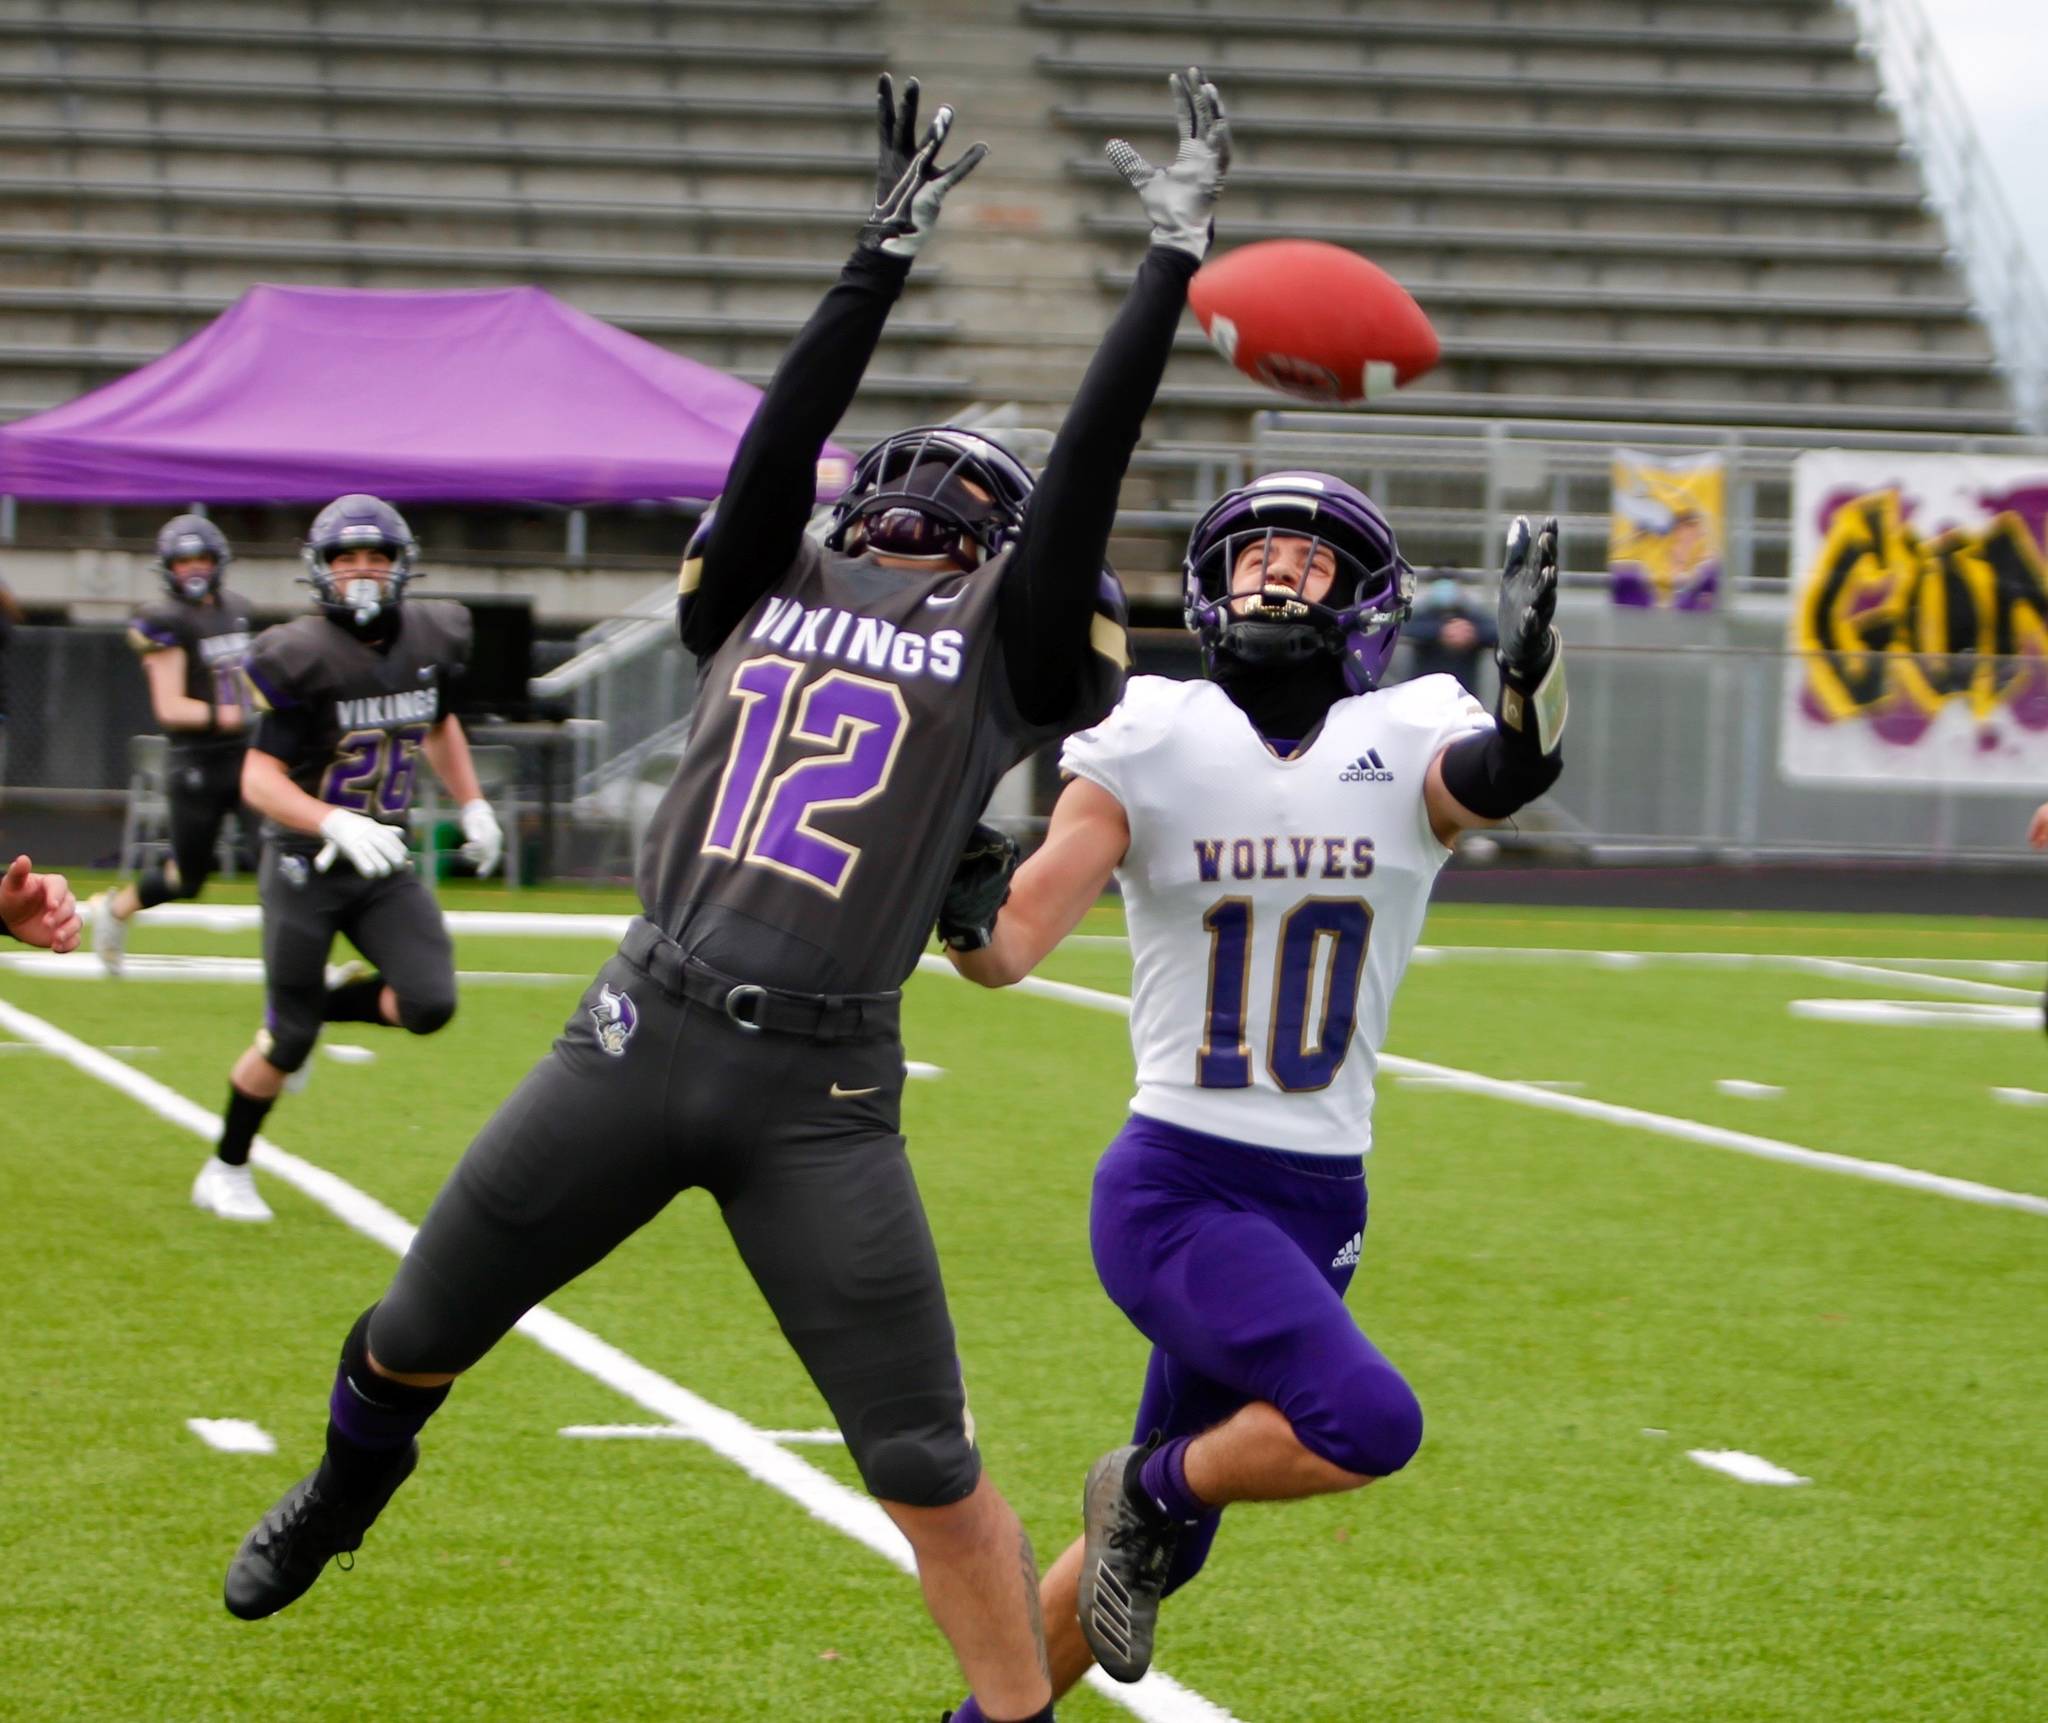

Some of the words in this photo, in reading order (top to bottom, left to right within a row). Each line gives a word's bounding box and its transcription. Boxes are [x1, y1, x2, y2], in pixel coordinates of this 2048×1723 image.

[751, 596, 964, 679] VIKINGS
[336, 687, 438, 727] VIKINGS
[319, 722, 431, 818] 26
[701, 653, 911, 898] 12
[1338, 768, 1394, 782] adidas
[1193, 837, 1376, 882] WOLVES
[1195, 894, 1375, 1093] 10
